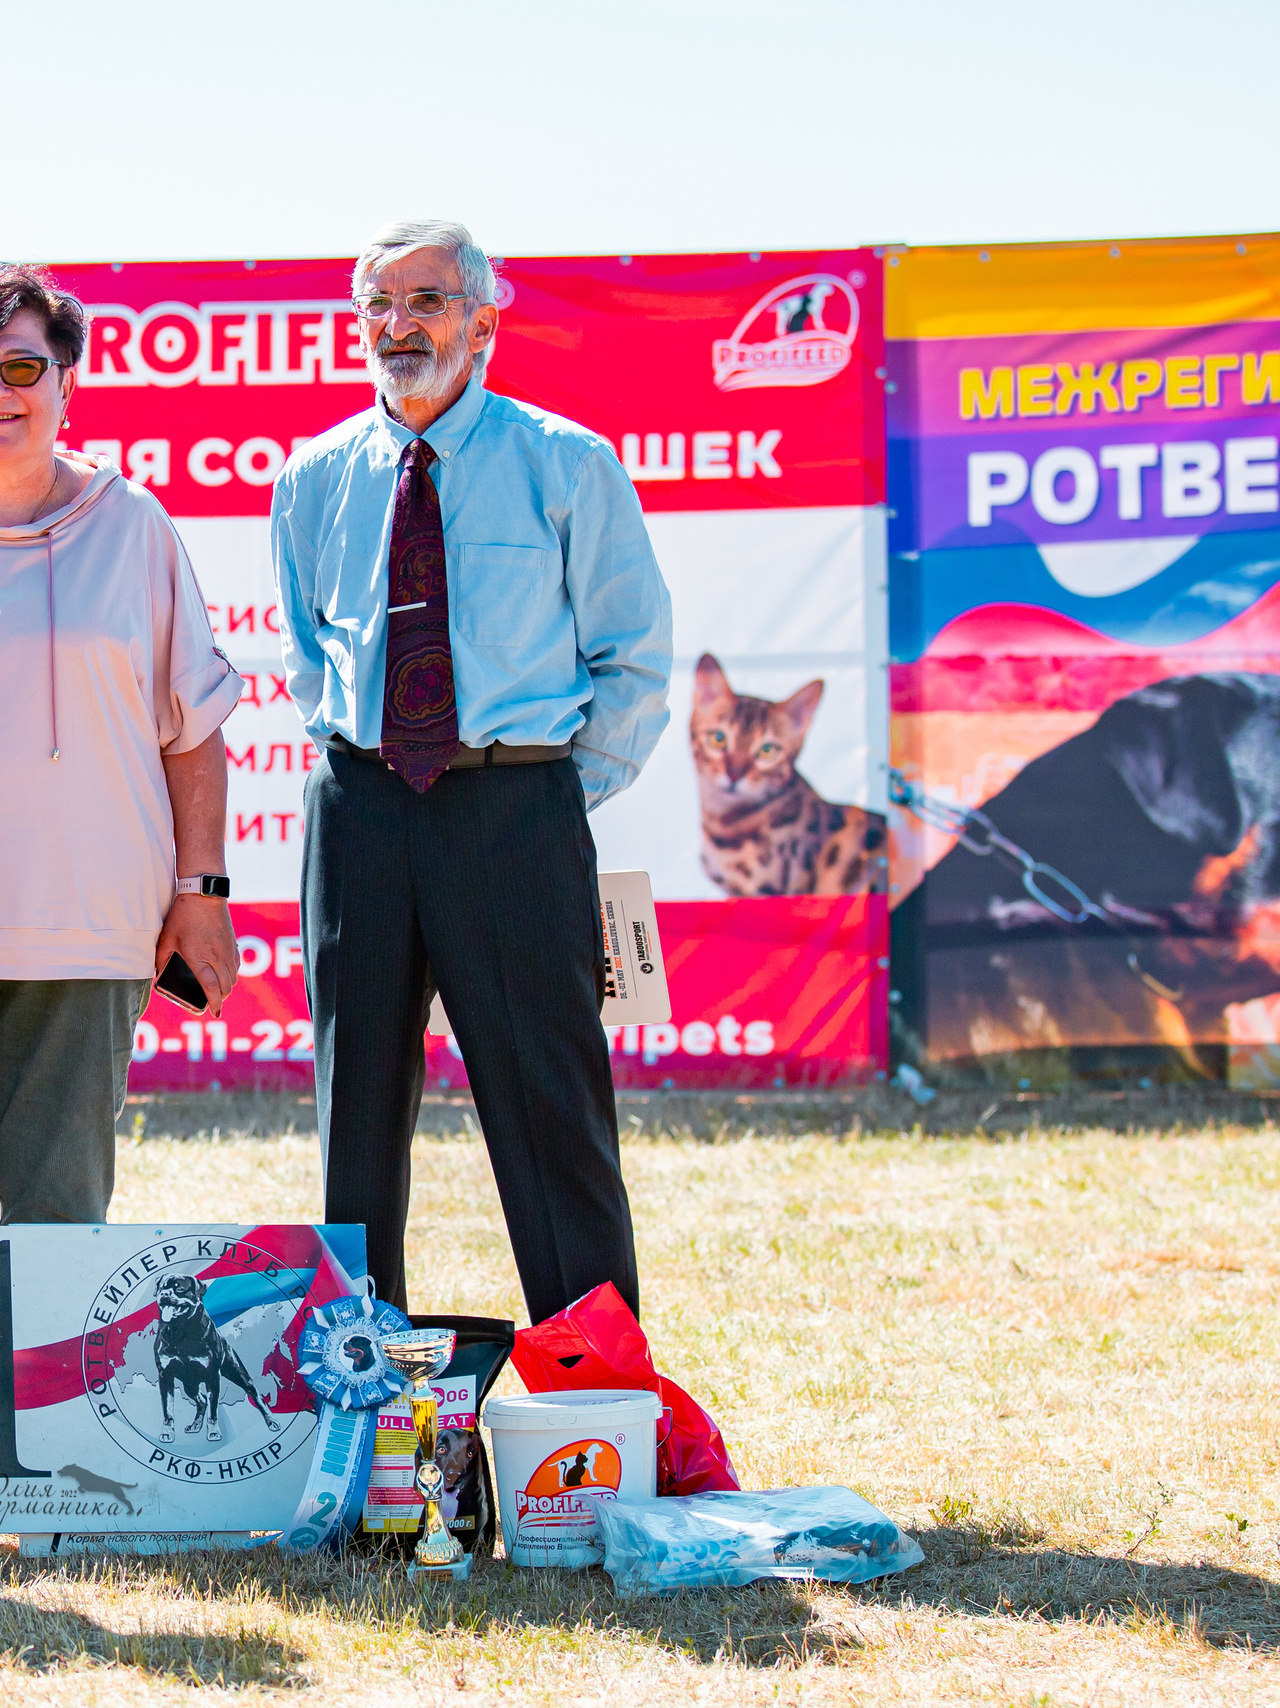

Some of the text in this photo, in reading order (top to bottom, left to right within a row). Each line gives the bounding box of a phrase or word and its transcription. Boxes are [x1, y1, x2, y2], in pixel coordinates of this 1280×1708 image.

[77, 302, 372, 388] ROFIFE
[621, 429, 783, 481] ШЕК
[605, 900, 615, 920] SERBIA
[632, 920, 646, 962] TABOOSPORT
[86, 1240, 283, 1419] РОТВЕЙЛЕР КЛУБ
[320, 1408, 358, 1477] JUNIOR
[377, 1415, 470, 1430] ULL EAT
[148, 1442, 282, 1479] РКФ-НКПР
[67, 1533, 106, 1545] Корма
[107, 1533, 147, 1543] нового
